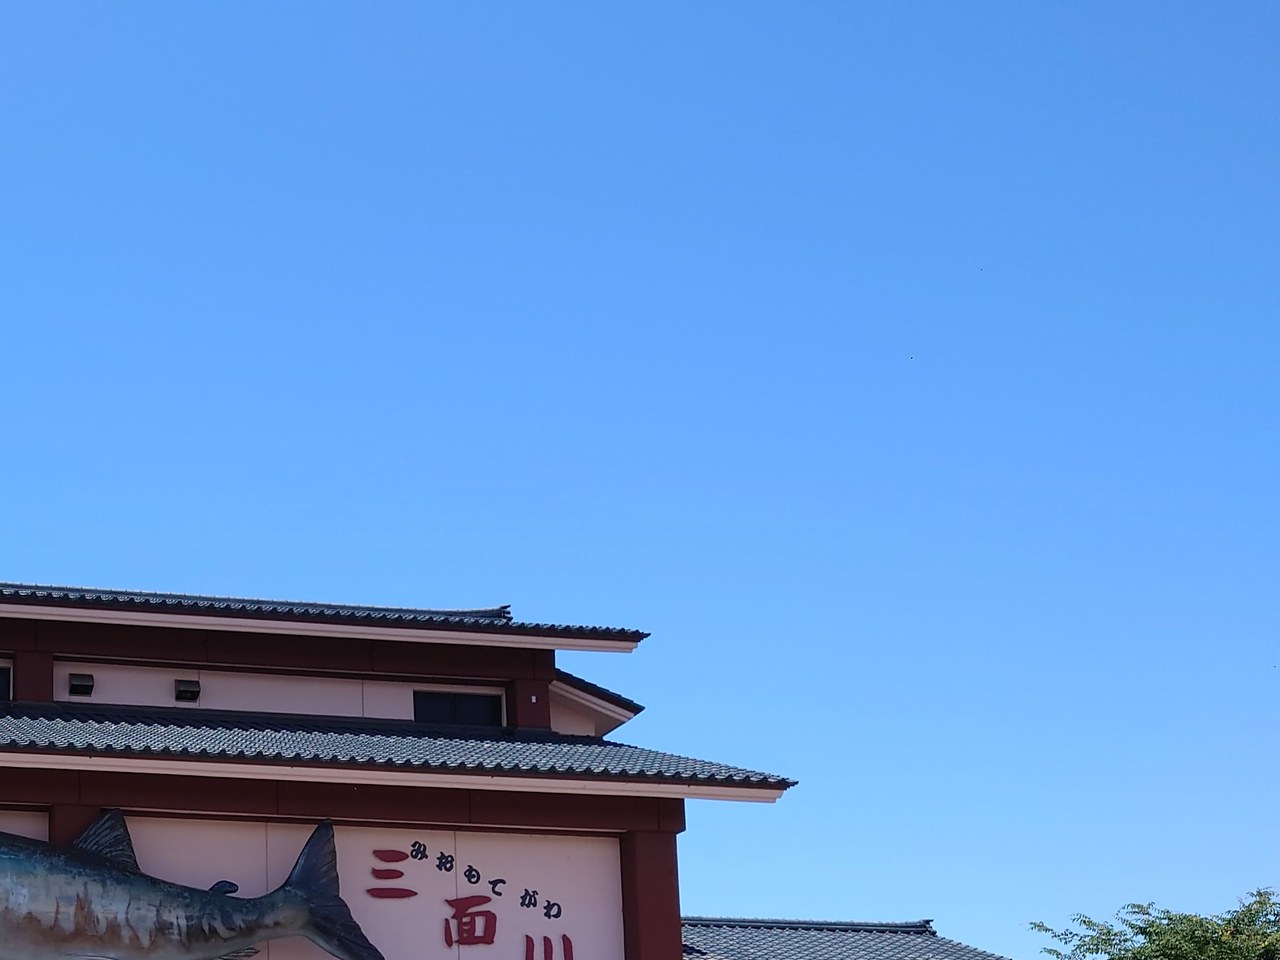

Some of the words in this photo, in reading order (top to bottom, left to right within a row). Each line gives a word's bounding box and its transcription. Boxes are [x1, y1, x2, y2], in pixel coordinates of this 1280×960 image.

[409, 840, 562, 920] みおもてがわ
